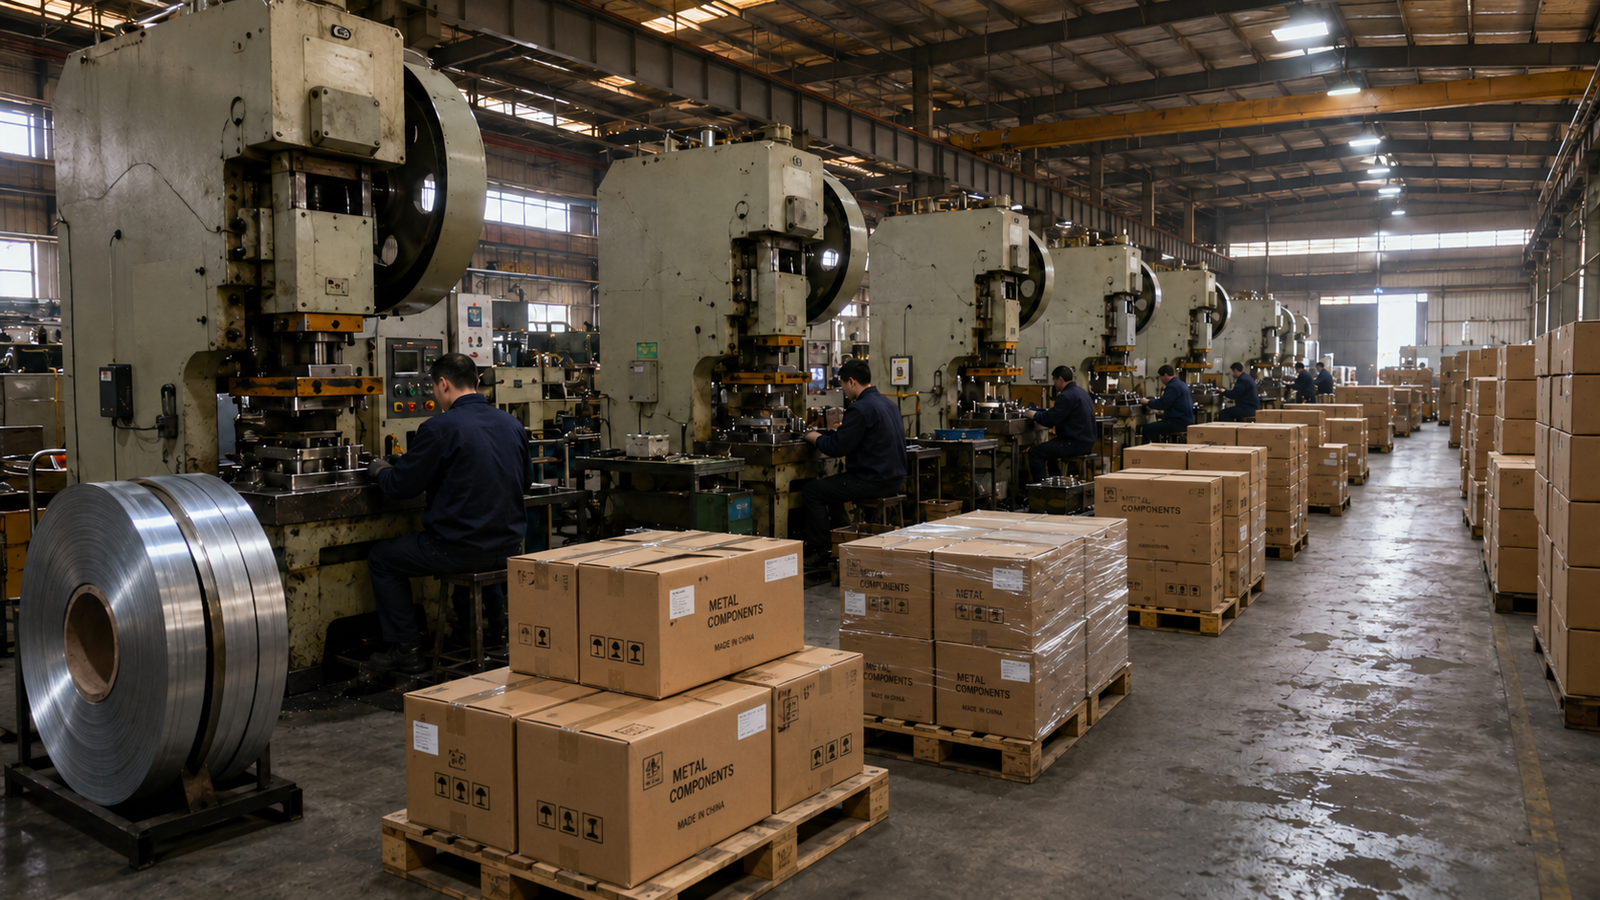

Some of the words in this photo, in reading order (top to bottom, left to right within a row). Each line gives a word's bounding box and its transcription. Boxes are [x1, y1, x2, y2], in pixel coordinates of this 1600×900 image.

[1121, 504, 1181, 515] COMPONENTS
[860, 580, 910, 592] COMPONENTS
[956, 588, 985, 600] METAL
[709, 594, 739, 612] METAL
[707, 603, 763, 628] COMPONENTS
[714, 639, 730, 651] MADE
[731, 638, 738, 646] IN
[738, 633, 755, 645] CHINA
[865, 662, 891, 673] METAL
[863, 672, 913, 686] COMPONENTS
[957, 672, 986, 685] METAL
[955, 684, 1011, 699] COMPONENTS
[672, 757, 708, 784] METAL
[669, 763, 734, 803] COMPONENTS
[677, 813, 696, 830] MADE
[698, 810, 705, 820] IN
[706, 800, 725, 816] CHINA
